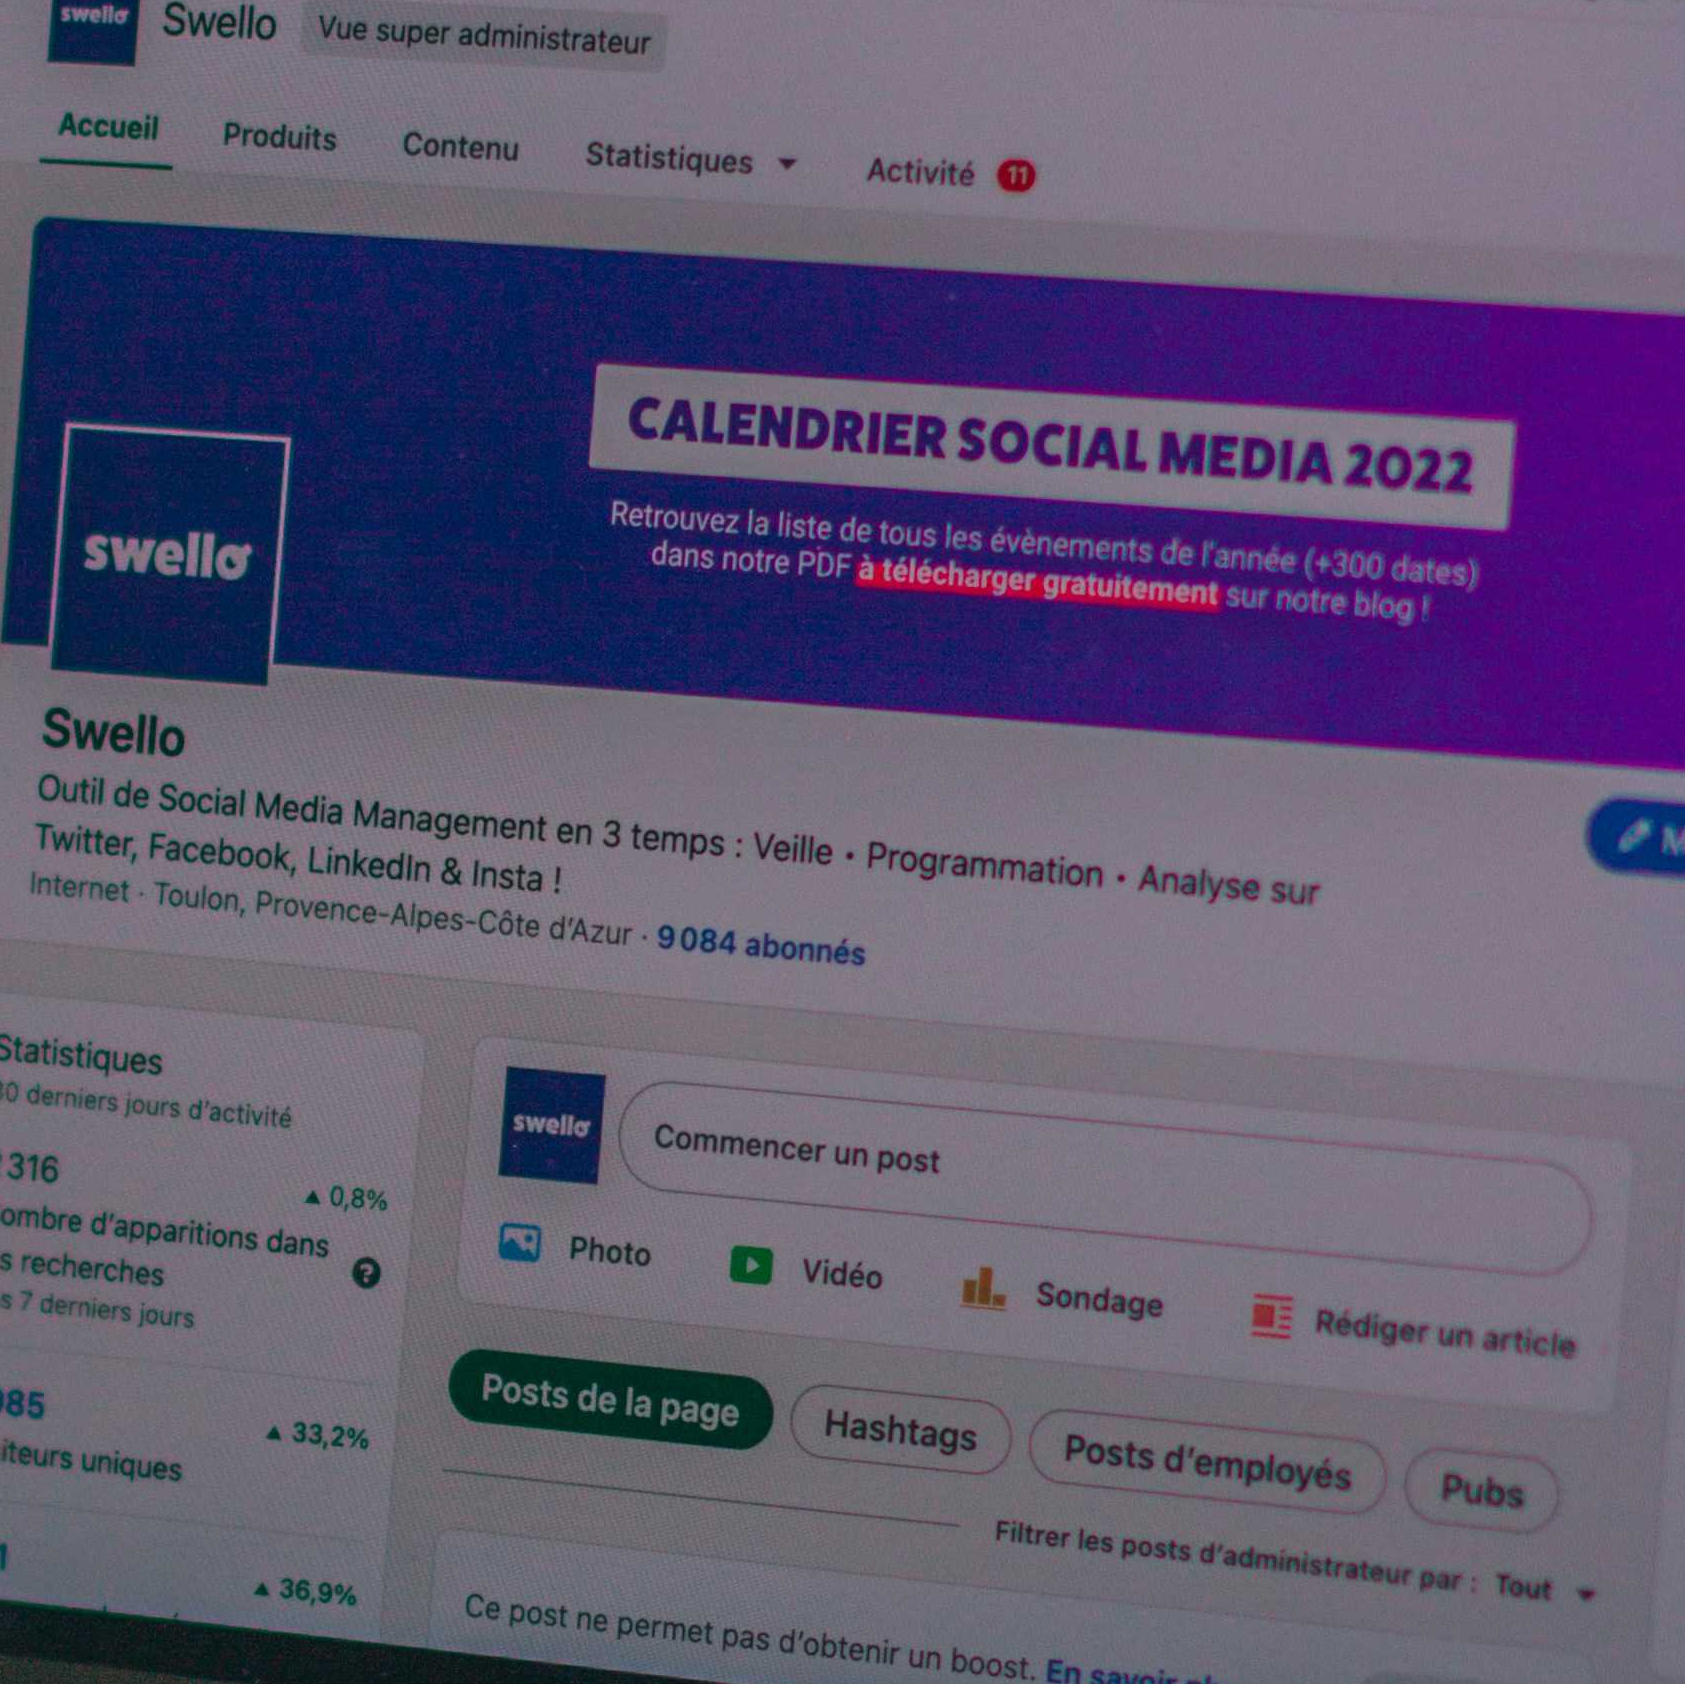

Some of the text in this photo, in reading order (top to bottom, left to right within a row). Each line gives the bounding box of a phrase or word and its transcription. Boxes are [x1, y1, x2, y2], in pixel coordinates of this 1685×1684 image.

[60, 3, 129, 27] swello
[163, 2, 276, 40] Swello
[319, 15, 651, 56] Vue super administrateur
[58, 113, 159, 141] Accueil
[224, 123, 337, 151] Produits
[403, 132, 519, 162] Contenu
[586, 142, 753, 175] Statistiques
[867, 158, 1028, 187] Activité 11
[628, 396, 1473, 494] CALENDRIER SOCIAL MEDIA 2022
[85, 531, 252, 581] swello
[611, 500, 738, 534] Retrouvez
[748, 510, 769, 537] la
[778, 511, 832, 540] liste
[839, 516, 871, 543] de
[880, 520, 936, 548] tous
[946, 523, 982, 551] les
[1161, 539, 1193, 565] de
[1202, 540, 1296, 574] l'année
[1304, 546, 1384, 582] (+300
[1391, 555, 1479, 592] dates)
[652, 541, 1414, 626] dans notre PDF à télécharger gratuitement sur notre blog
[42, 708, 185, 757] Swello
[35, 823, 544, 892] Twitter, Facebook, LinkedIn & Insta
[38, 774, 1321, 905] Outil de Social Media Management en 3 temps Veille Programmation Analyse sur
[30, 871, 130, 903] Internet
[154, 883, 244, 916] Toulon,
[256, 891, 540, 939] Provence-Alpes-Côte
[550, 917, 632, 947] d'Azur
[745, 933, 866, 966] abonnés
[26, 1084, 118, 1113] derniers
[124, 1093, 181, 1118] jours
[189, 1100, 292, 1129] d'activité
[513, 1114, 591, 1138] swello
[654, 1124, 940, 1174] Commencer un post
[330, 1186, 388, 1212] 0,8%
[91, 1211, 258, 1251] d'apparitions
[267, 1229, 330, 1258] dans
[570, 1236, 652, 1267] Photo
[21, 1253, 165, 1287] recherches
[803, 1257, 884, 1290] Vidéo
[20, 1291, 33, 1310] 7
[40, 1294, 132, 1322] derniers
[138, 1303, 195, 1329] jours
[1037, 1282, 1163, 1321] Sondage
[1316, 1309, 1577, 1359] Rédiger un article
[483, 1373, 740, 1433] Posts de la page
[292, 1422, 369, 1452] 33,2%
[825, 1409, 978, 1455] Hashtags
[81, 1451, 182, 1482] uniques
[1065, 1434, 1352, 1492] Posts d'employés
[1442, 1474, 1526, 1509] Pubs
[995, 1520, 1552, 1601] Filtrer les posts d'administrateur par Tout
[280, 1578, 357, 1607] 36,9%
[465, 1593, 501, 1621] Ce
[508, 1600, 568, 1632] post
[576, 1611, 608, 1633] ne
[617, 1616, 714, 1646] permet
[722, 1624, 770, 1654] pas
[779, 1630, 899, 1666] d'obtenir
[908, 1646, 942, 1670] un
[951, 1649, 1037, 1682] boost.
